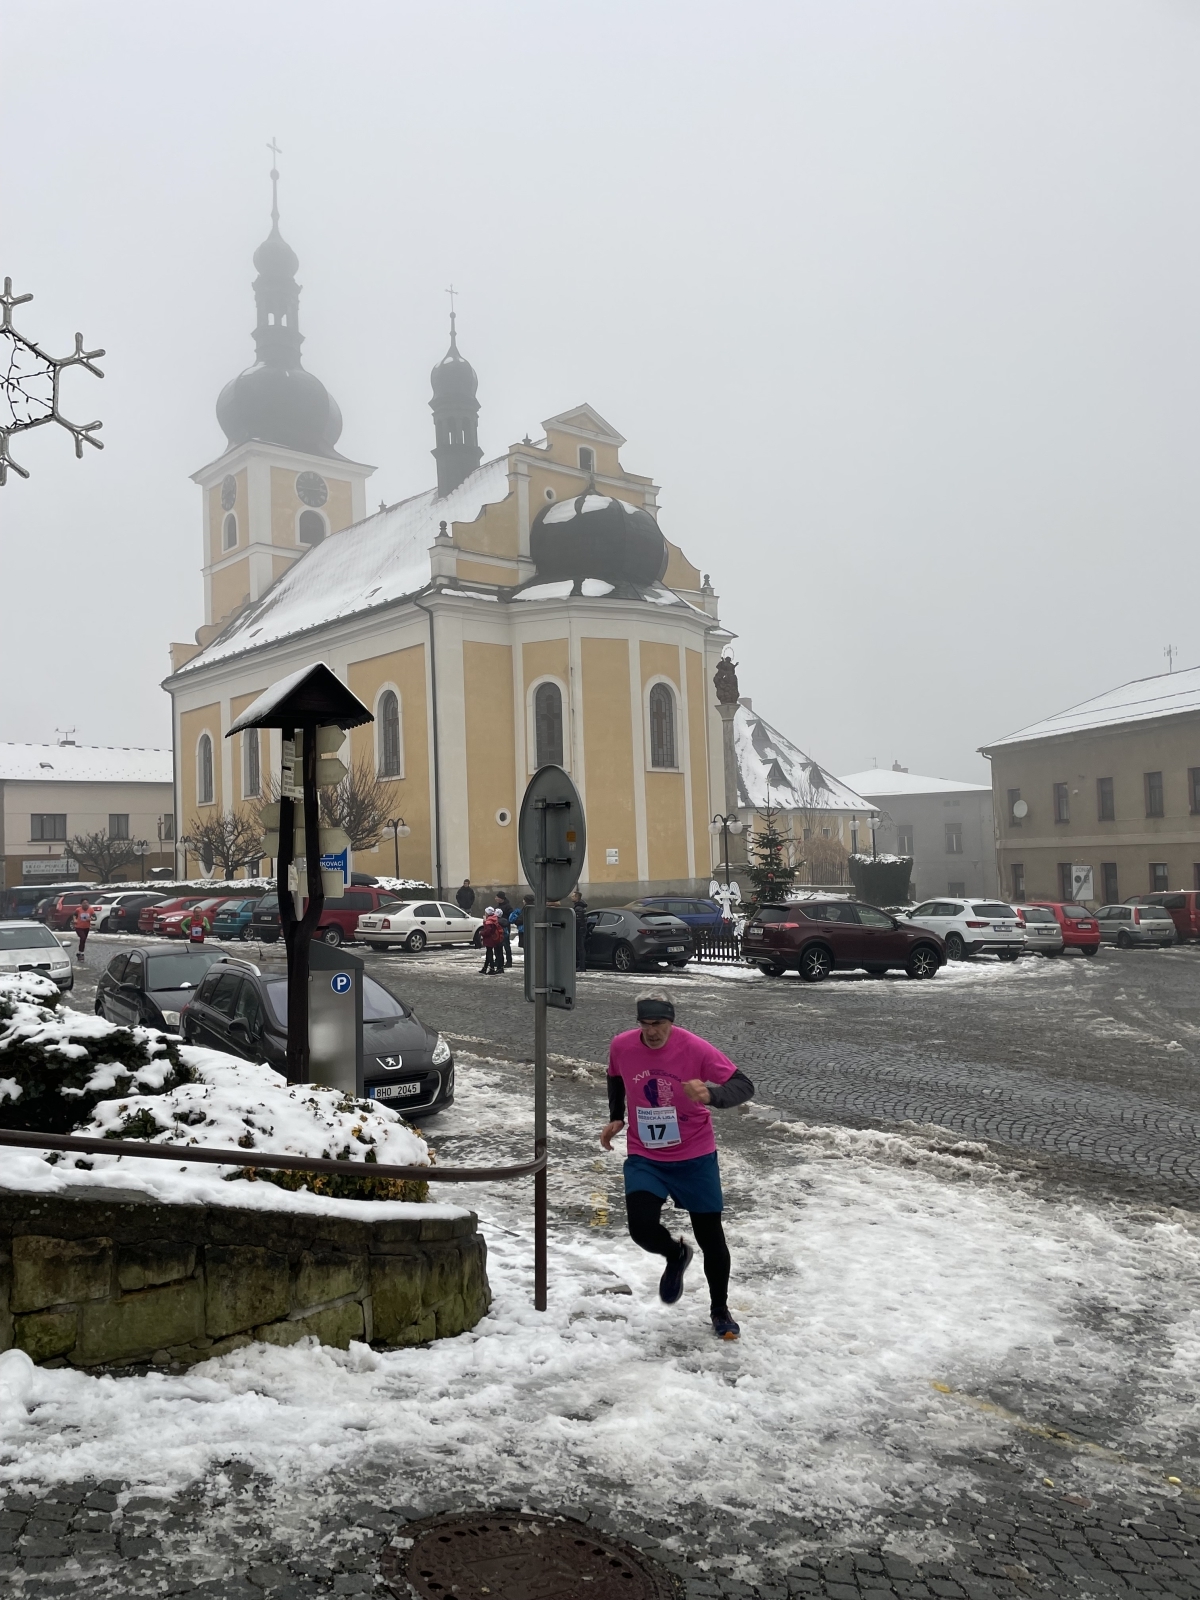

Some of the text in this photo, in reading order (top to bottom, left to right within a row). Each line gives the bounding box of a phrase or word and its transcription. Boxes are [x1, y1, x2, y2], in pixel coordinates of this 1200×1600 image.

[337, 977, 347, 990] P
[632, 1070, 650, 1084] XVII
[397, 1084, 417, 1095] 2045
[647, 1124, 666, 1140] 17
